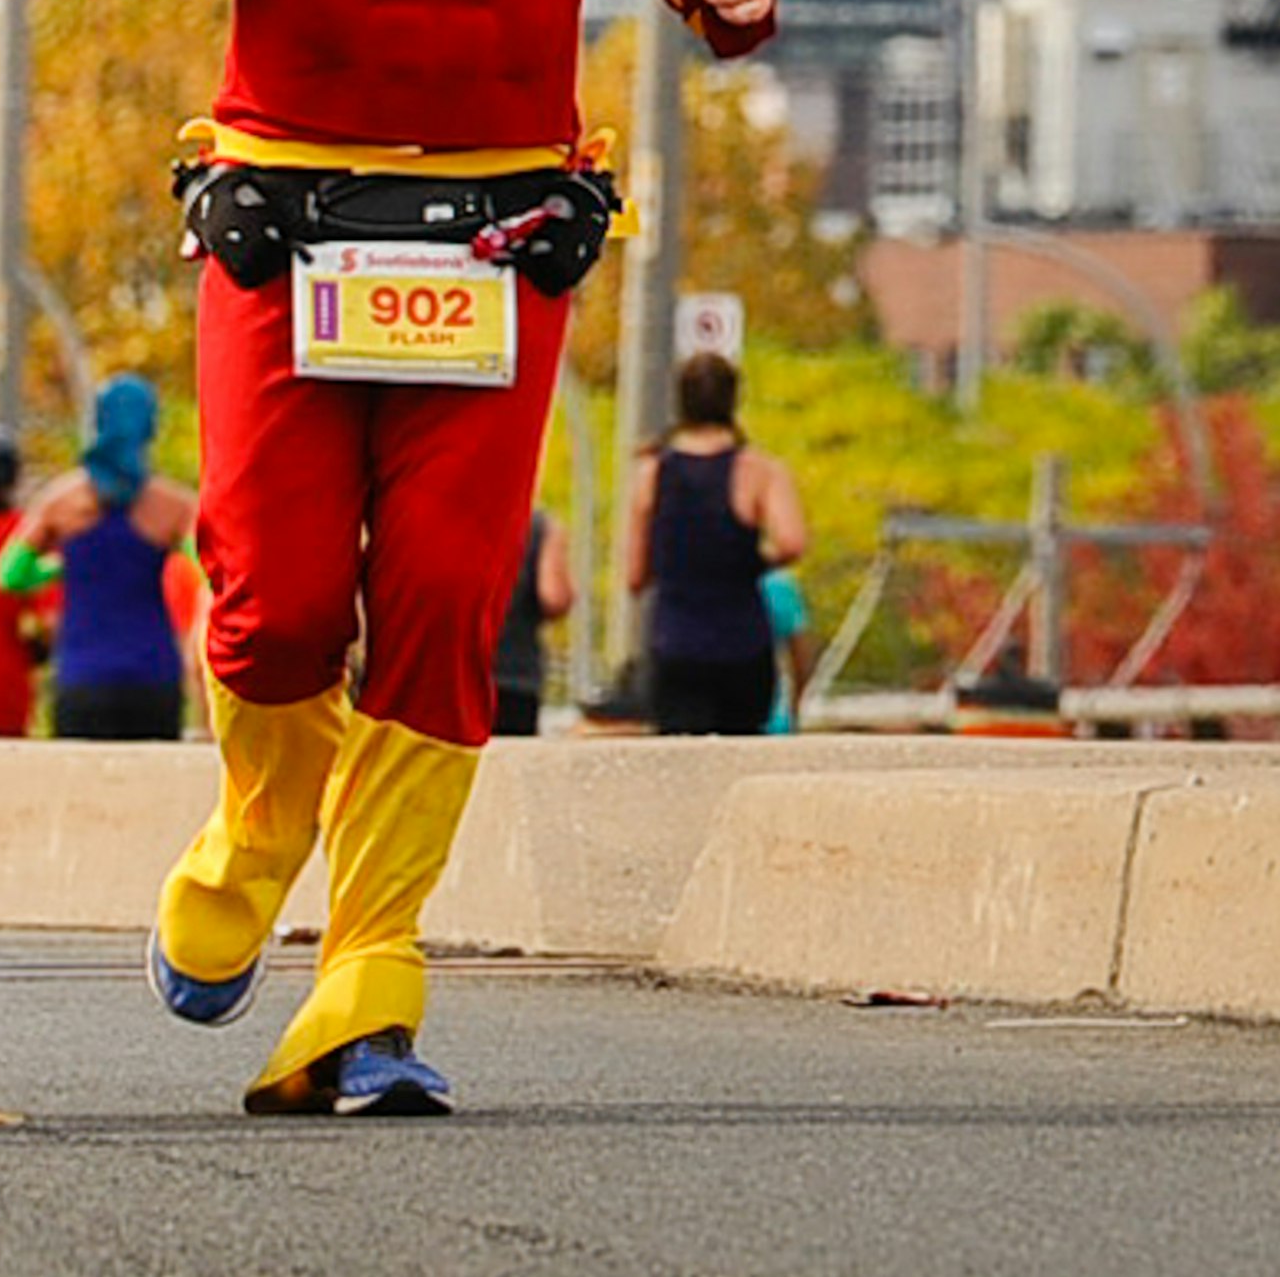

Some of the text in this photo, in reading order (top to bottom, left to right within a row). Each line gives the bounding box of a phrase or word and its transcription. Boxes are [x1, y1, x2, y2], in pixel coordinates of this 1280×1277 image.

[366, 253, 464, 269] Scotiabank
[369, 285, 474, 328] 902
[388, 332, 455, 346] FLASH
